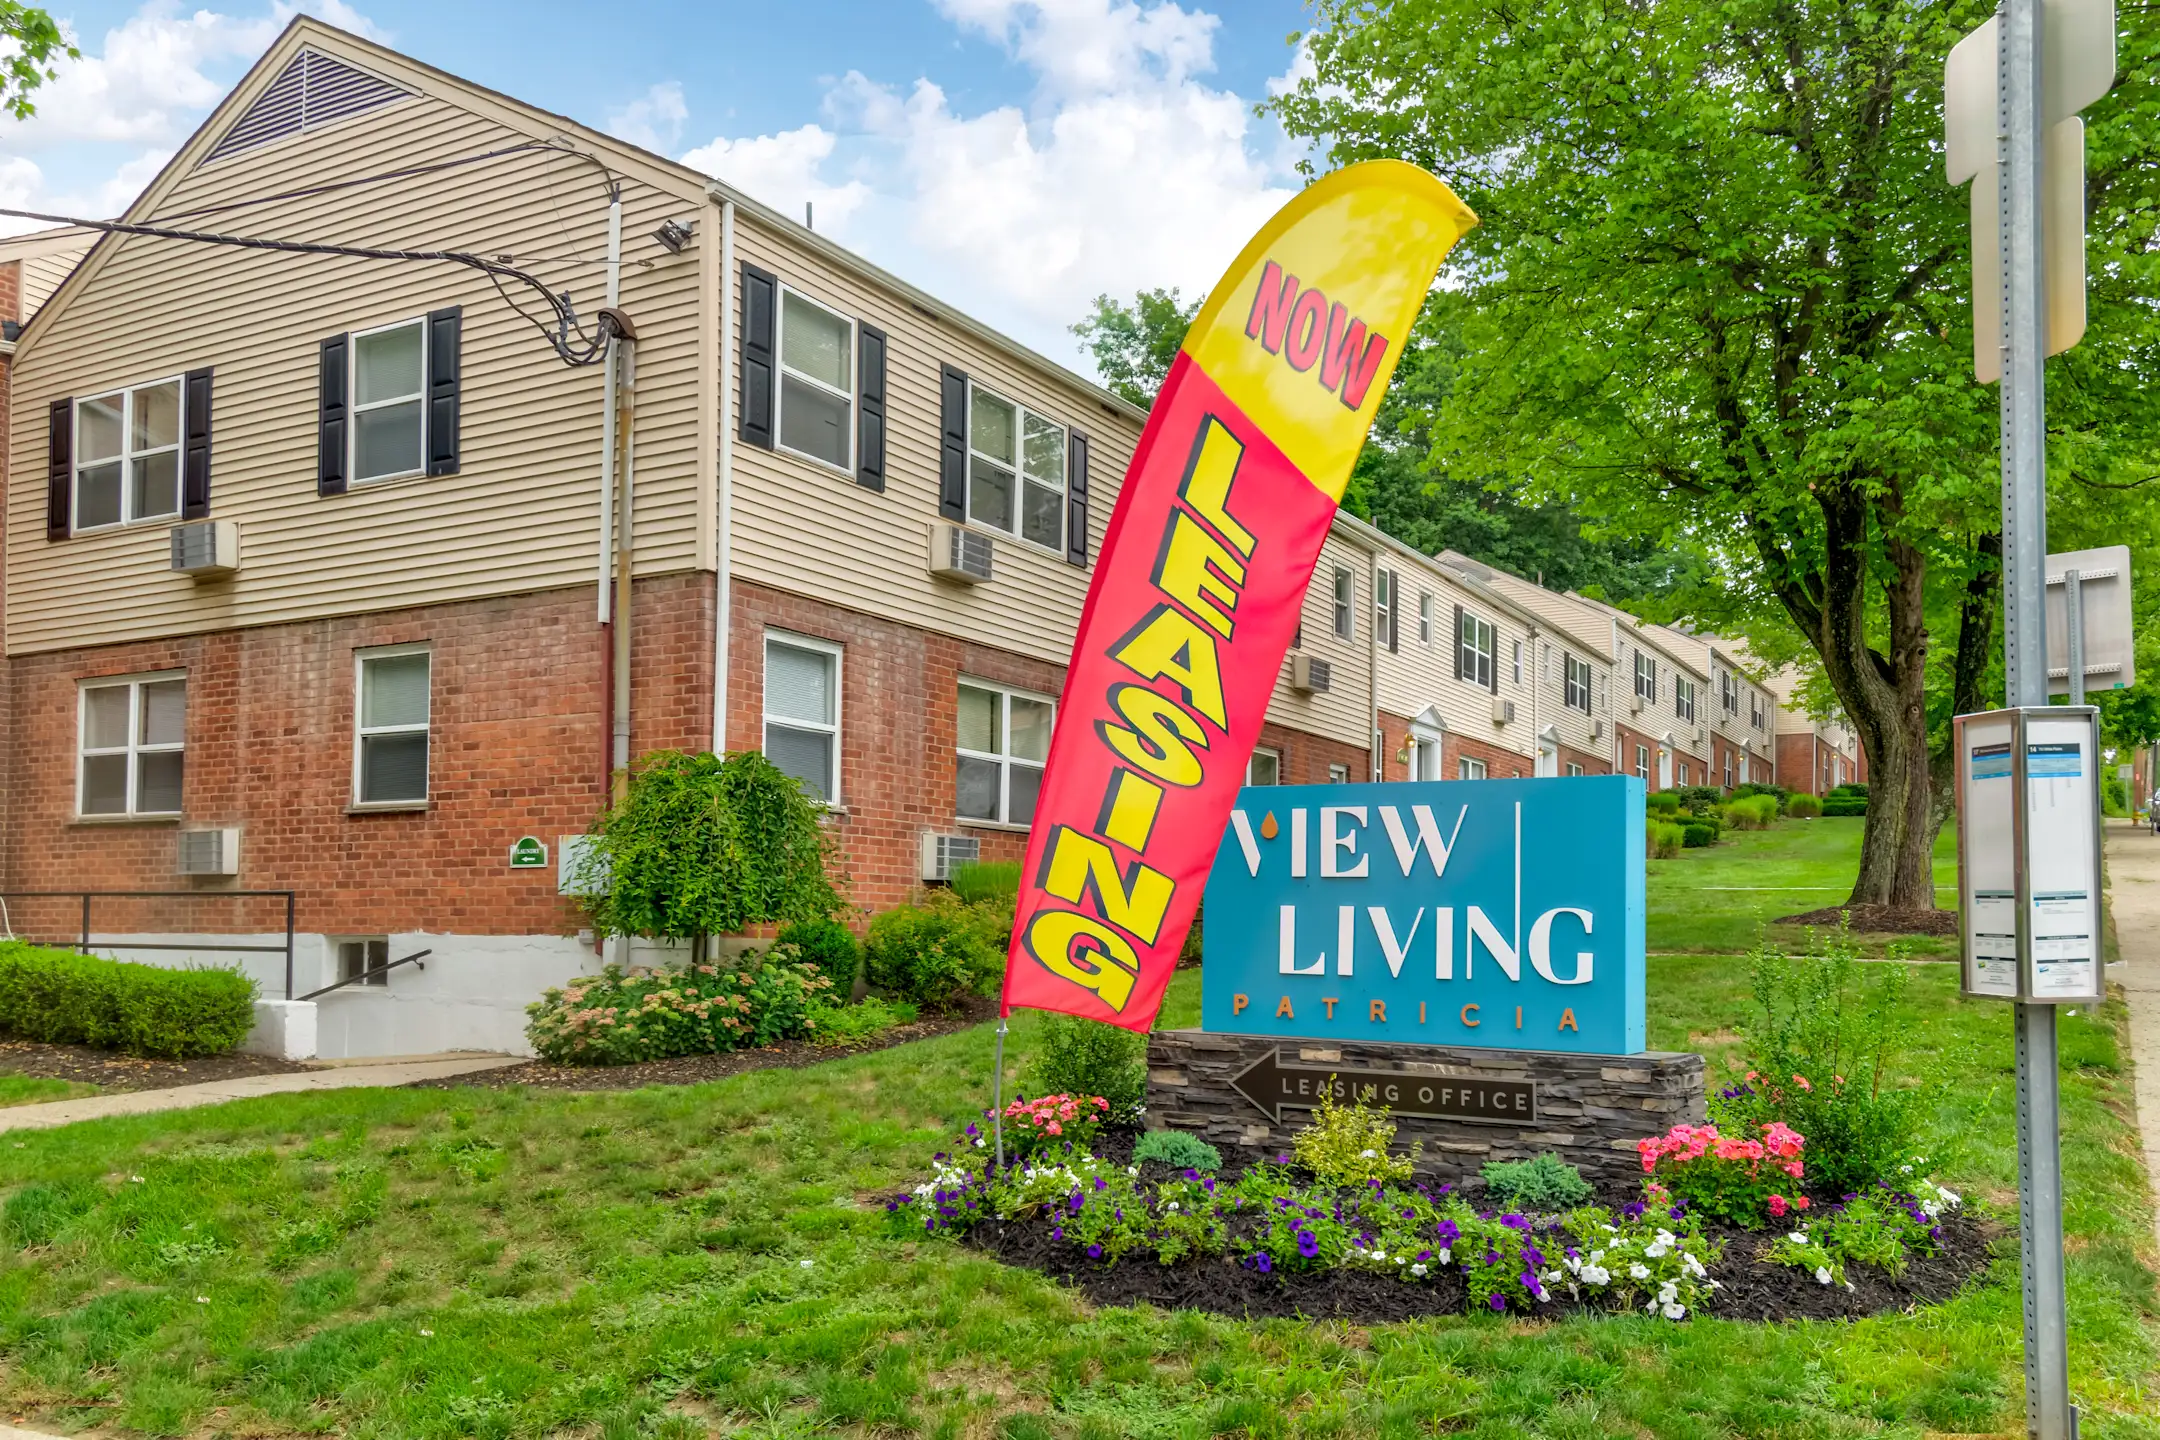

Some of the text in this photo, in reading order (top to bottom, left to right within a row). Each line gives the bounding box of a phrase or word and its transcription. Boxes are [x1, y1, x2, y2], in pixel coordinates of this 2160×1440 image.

[1245, 259, 1389, 412] NOW
[1020, 412, 1258, 1014] LEASING
[1230, 803, 1469, 878] VIEW
[1278, 801, 1594, 985] LIVING
[1232, 993, 1579, 1032] PATRICIA
[1281, 1077, 1528, 1112] LEASING OFFICE
